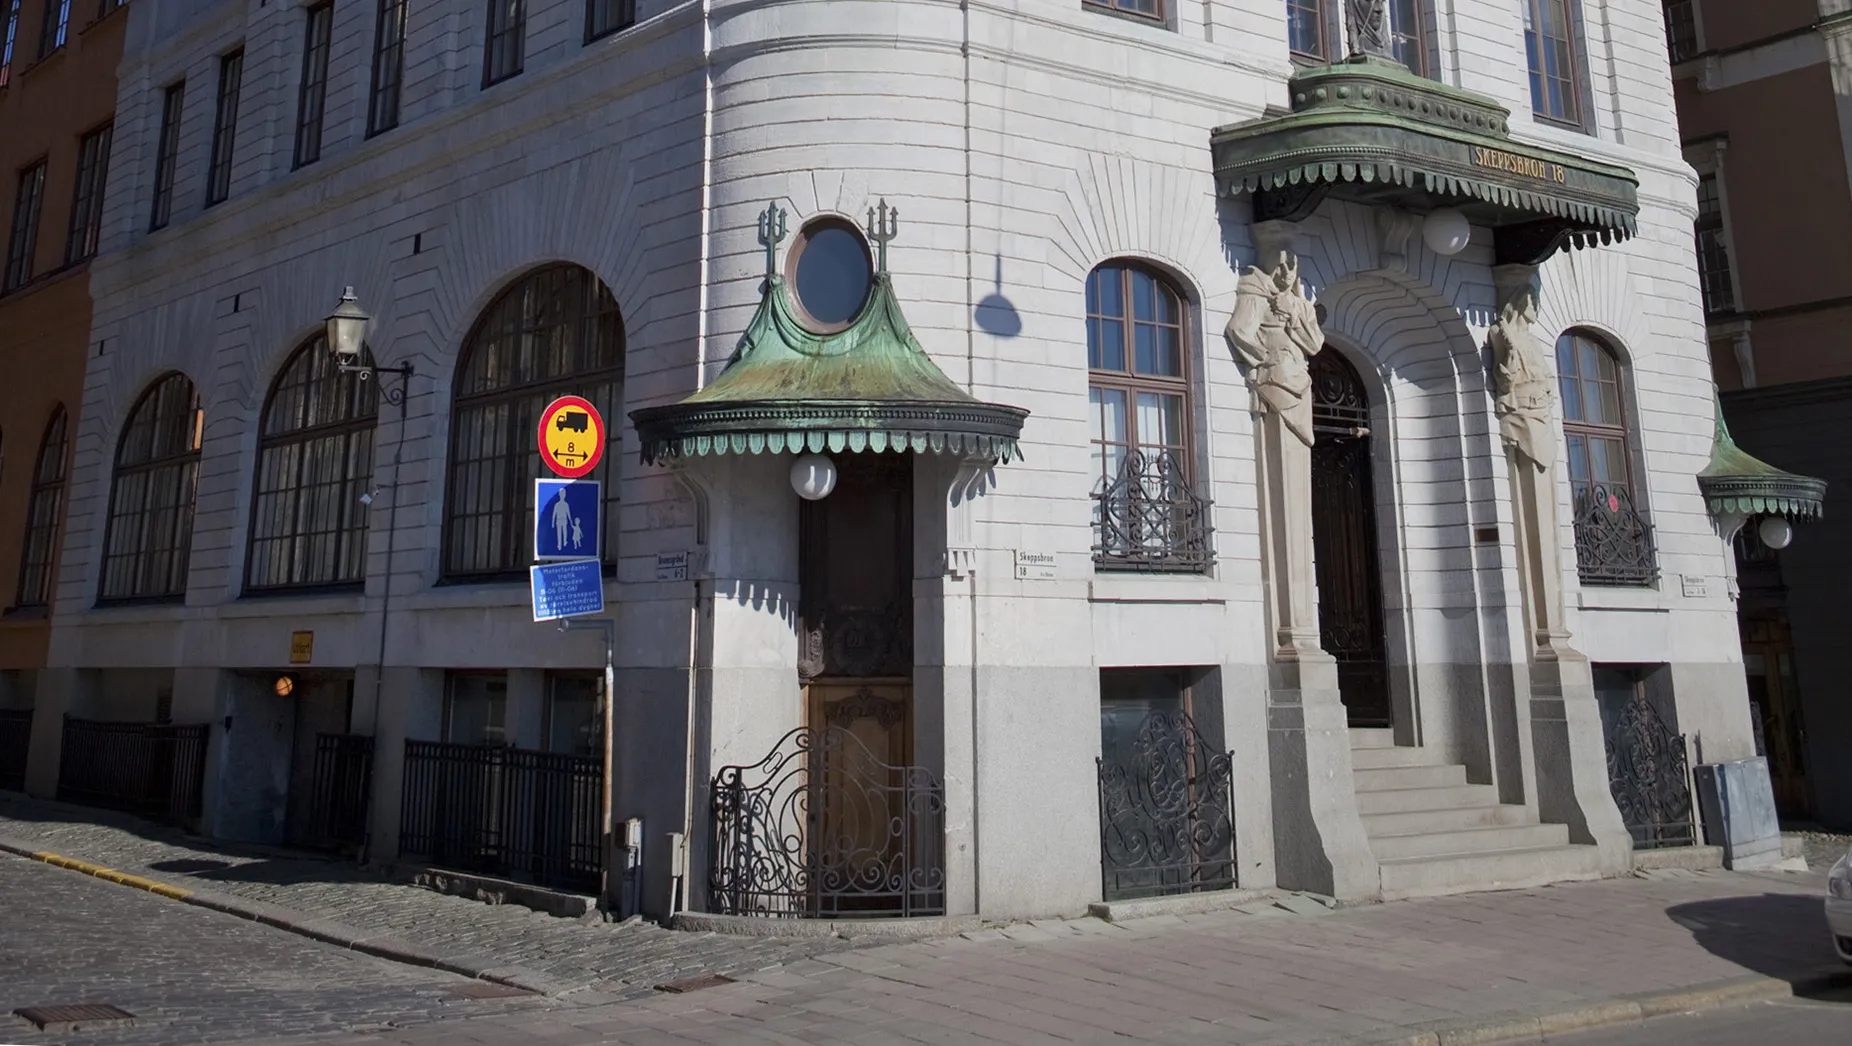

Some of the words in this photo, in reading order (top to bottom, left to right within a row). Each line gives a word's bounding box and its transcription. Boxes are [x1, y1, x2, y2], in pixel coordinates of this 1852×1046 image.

[1475, 147, 1546, 179] SKEPPSBRON
[1551, 164, 1565, 184] 18
[568, 442, 575, 453] 8
[565, 458, 575, 467] m
[1020, 551, 1054, 564] Skeppsbron
